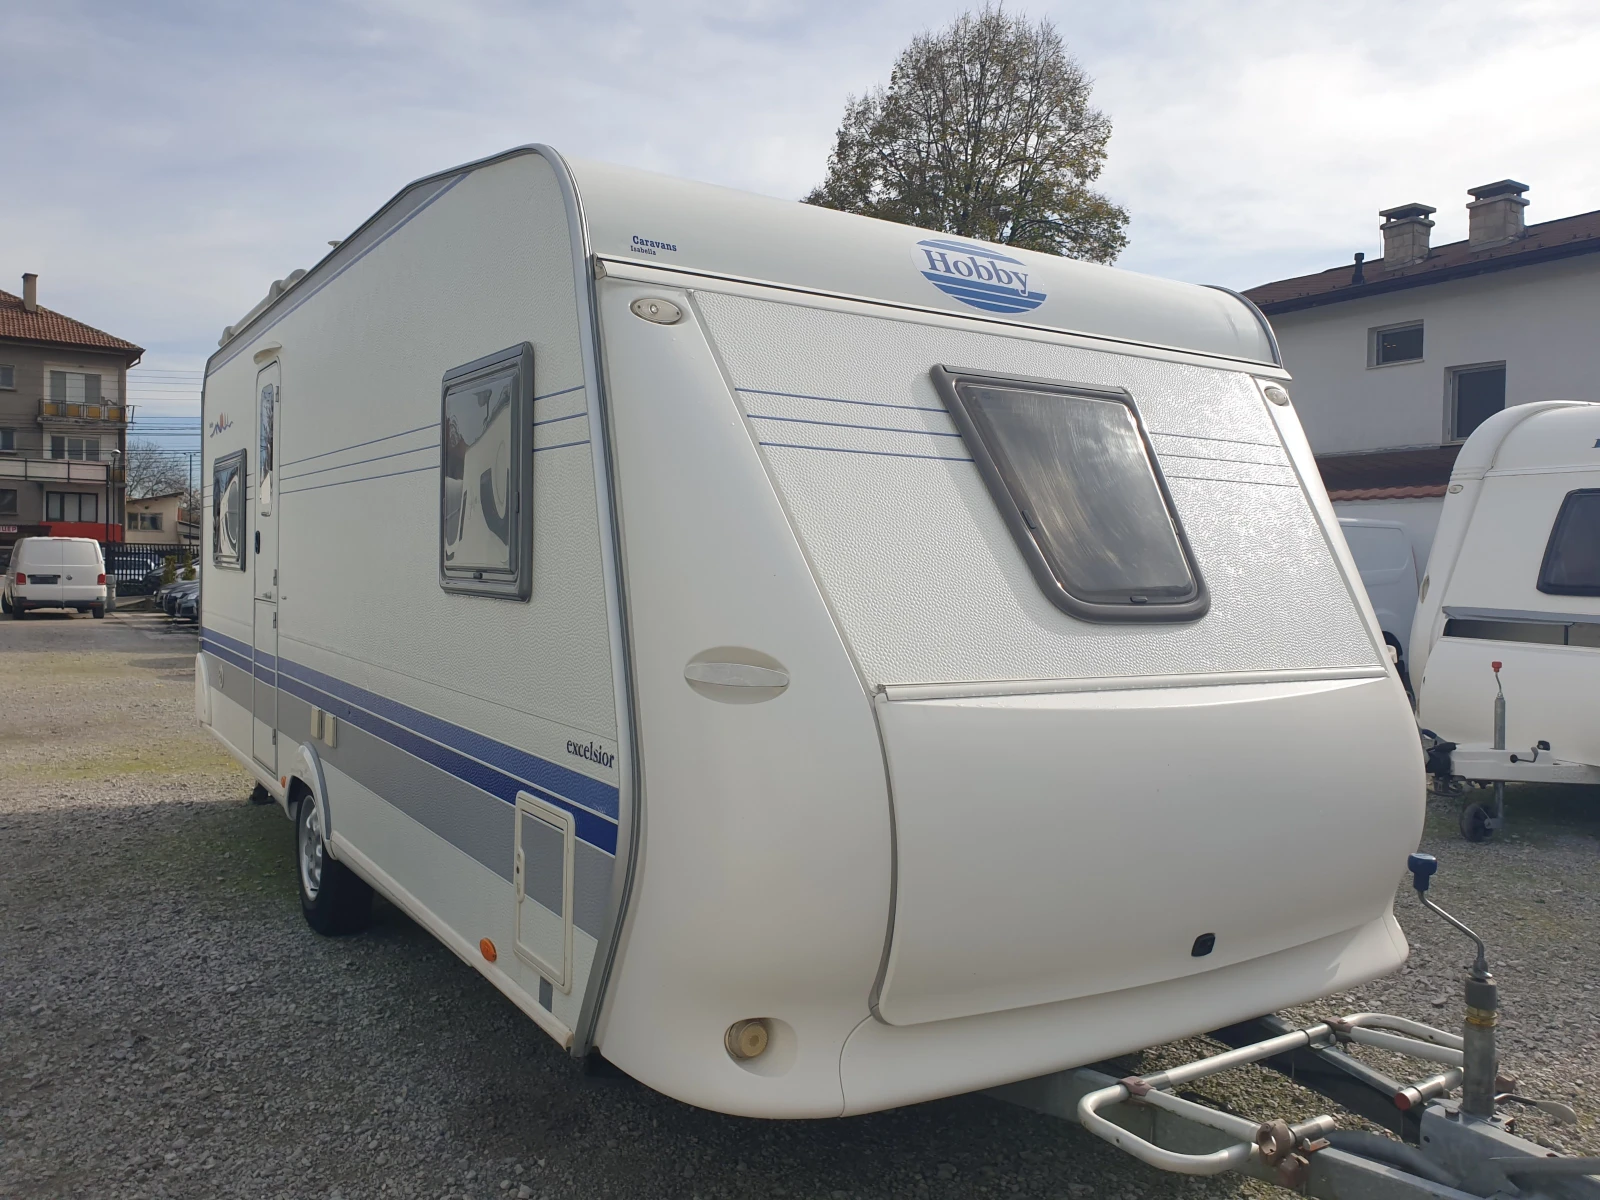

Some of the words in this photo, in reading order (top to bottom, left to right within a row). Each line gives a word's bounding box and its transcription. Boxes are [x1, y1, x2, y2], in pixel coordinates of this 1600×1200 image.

[630, 245, 657, 256] Isabella
[632, 235, 677, 252] Caravans
[921, 248, 1029, 295] Hobby
[566, 740, 615, 768] excelsior
